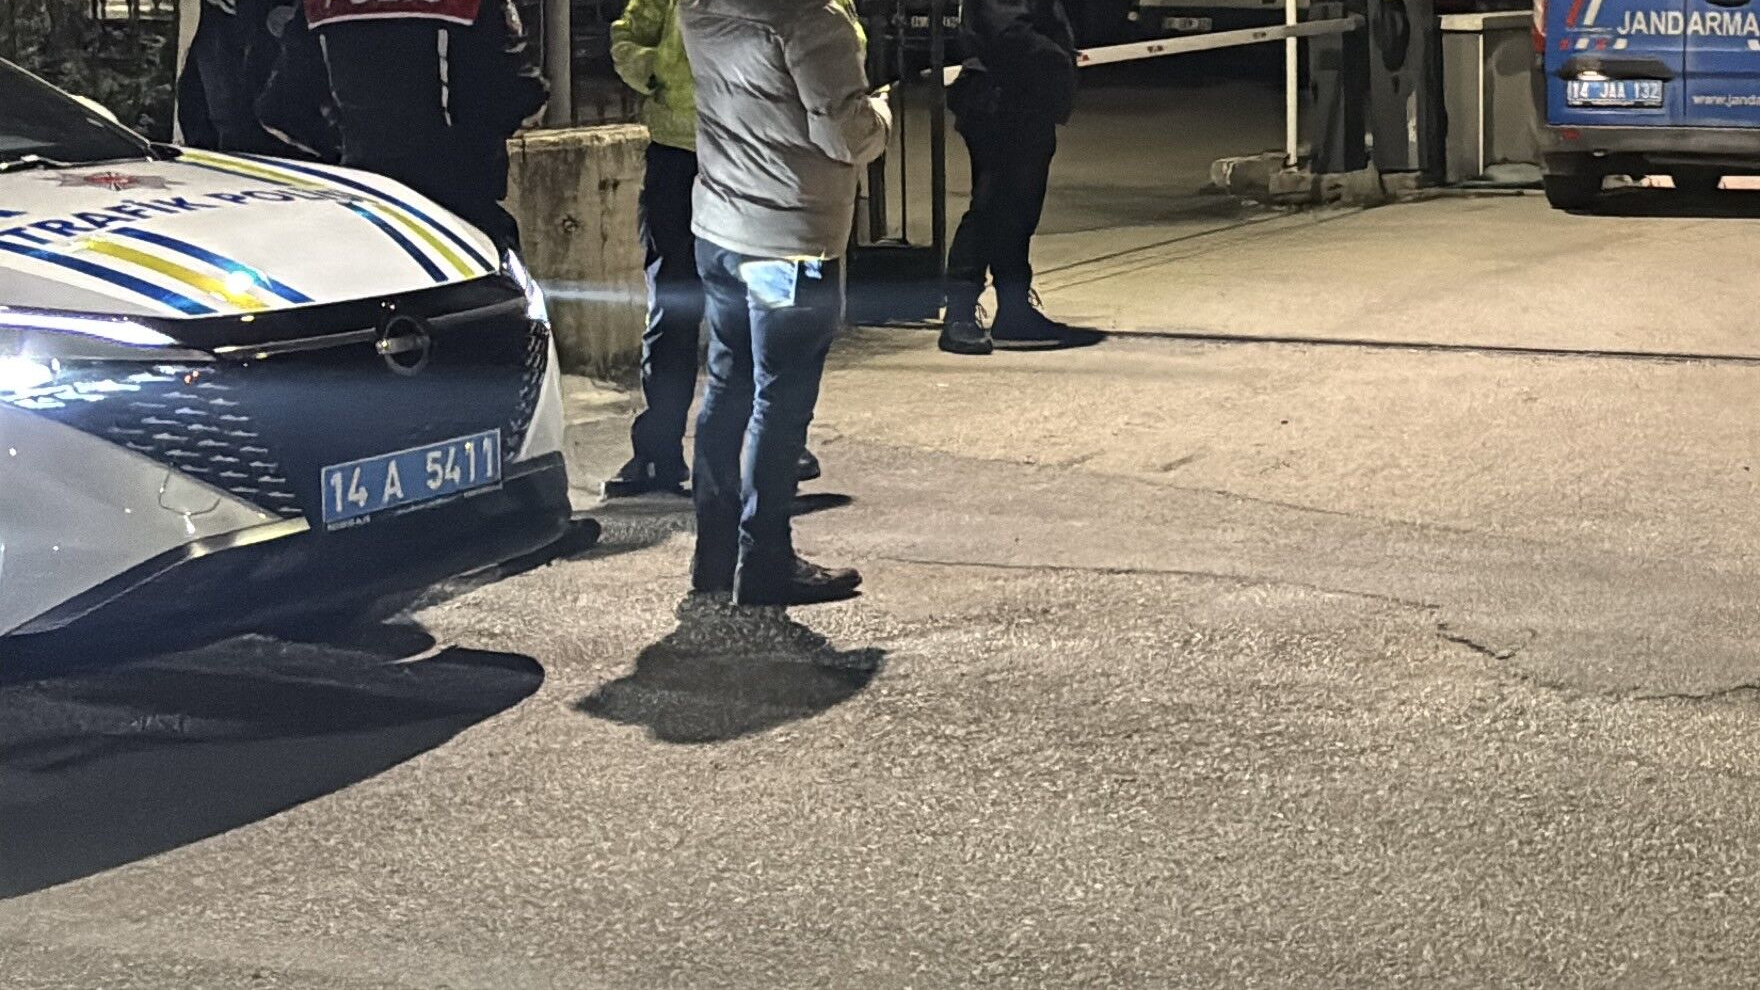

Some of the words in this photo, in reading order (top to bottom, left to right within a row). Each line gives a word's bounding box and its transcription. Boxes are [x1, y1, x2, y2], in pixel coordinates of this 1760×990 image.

[1616, 10, 1760, 36] JANDARMA
[330, 466, 369, 513] 14
[382, 459, 405, 505] A
[426, 436, 493, 491] 5411
